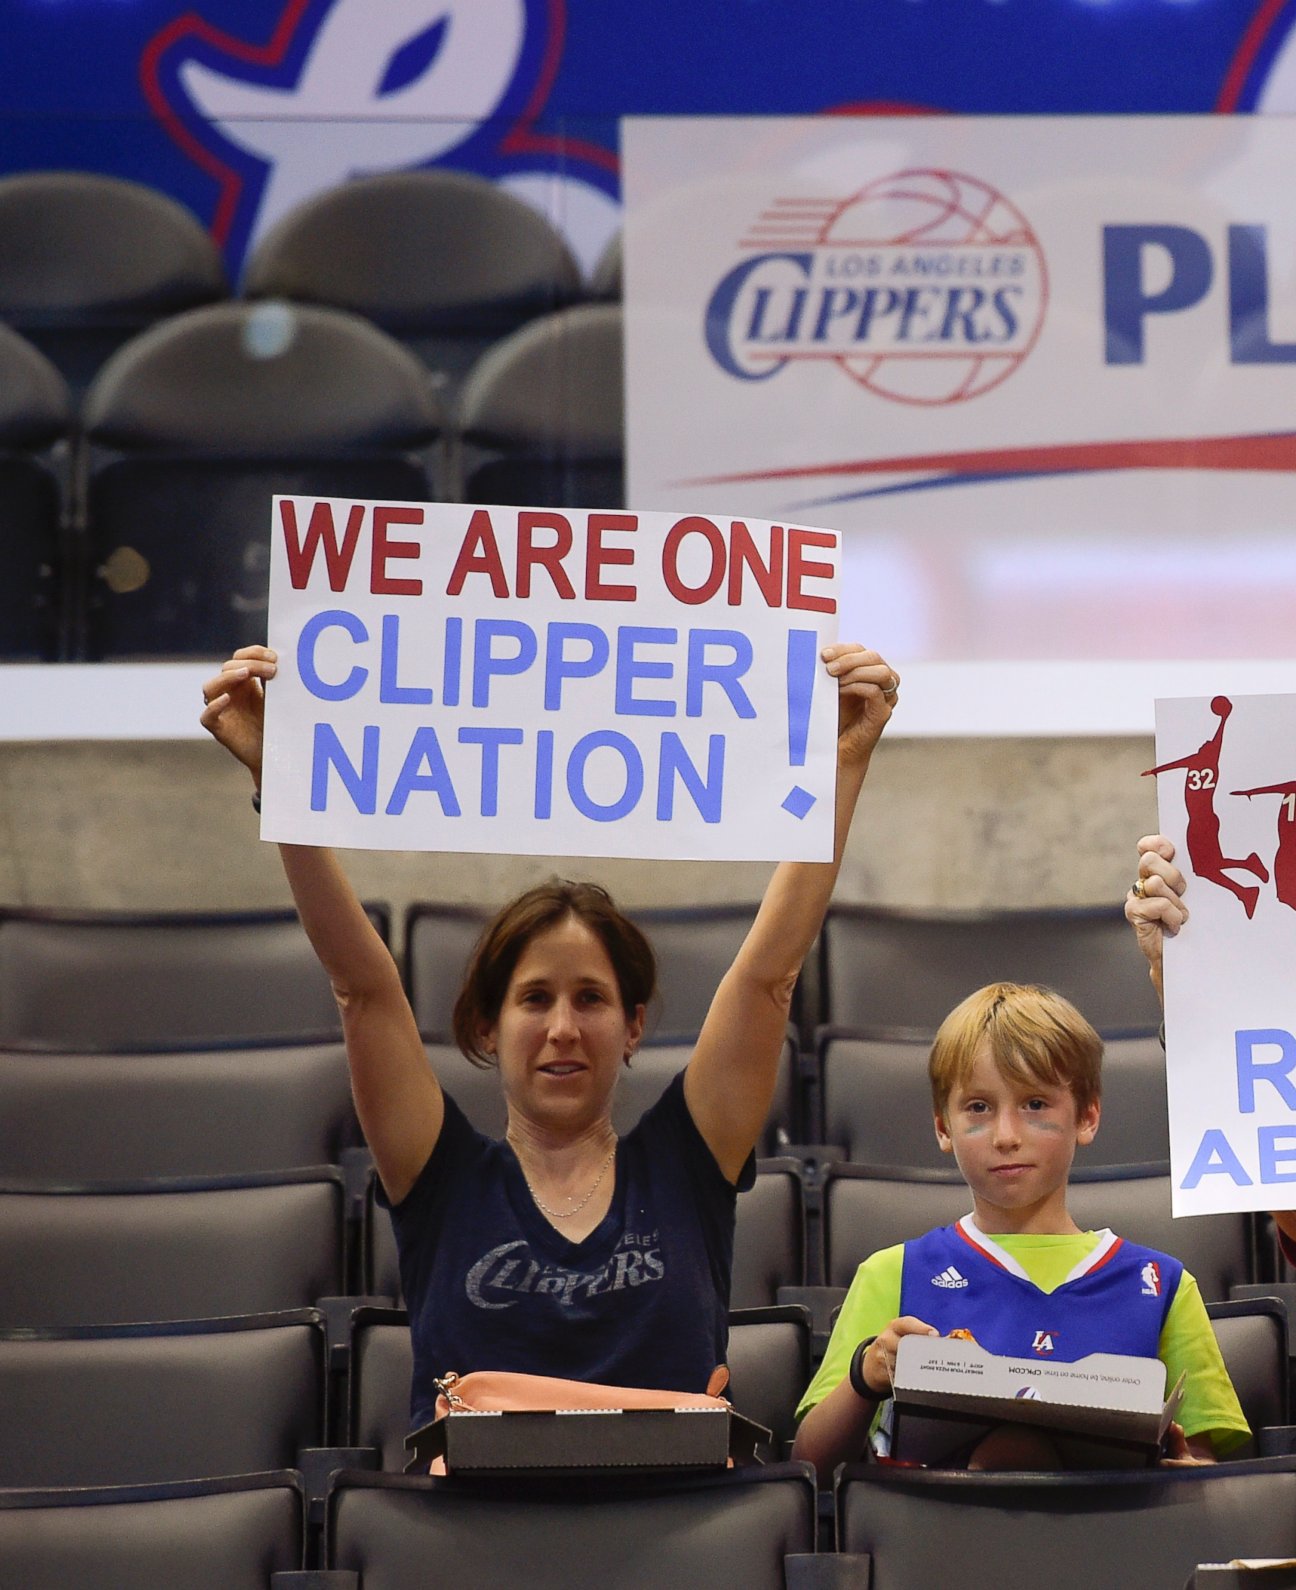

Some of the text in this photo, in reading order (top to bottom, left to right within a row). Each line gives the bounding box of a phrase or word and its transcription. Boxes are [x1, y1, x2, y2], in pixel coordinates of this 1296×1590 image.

[825, 254, 1025, 277] LOS ANGELES
[704, 252, 1023, 384] CLIPPERS
[279, 500, 837, 615] WE ARE ONE
[296, 609, 758, 720] CLIPPER
[310, 723, 726, 824] NATION
[1188, 768, 1215, 790] 32
[931, 1278, 968, 1289] adidas
[1008, 1366, 1041, 1375] CPK.COM
[1070, 1372, 1088, 1380] home
